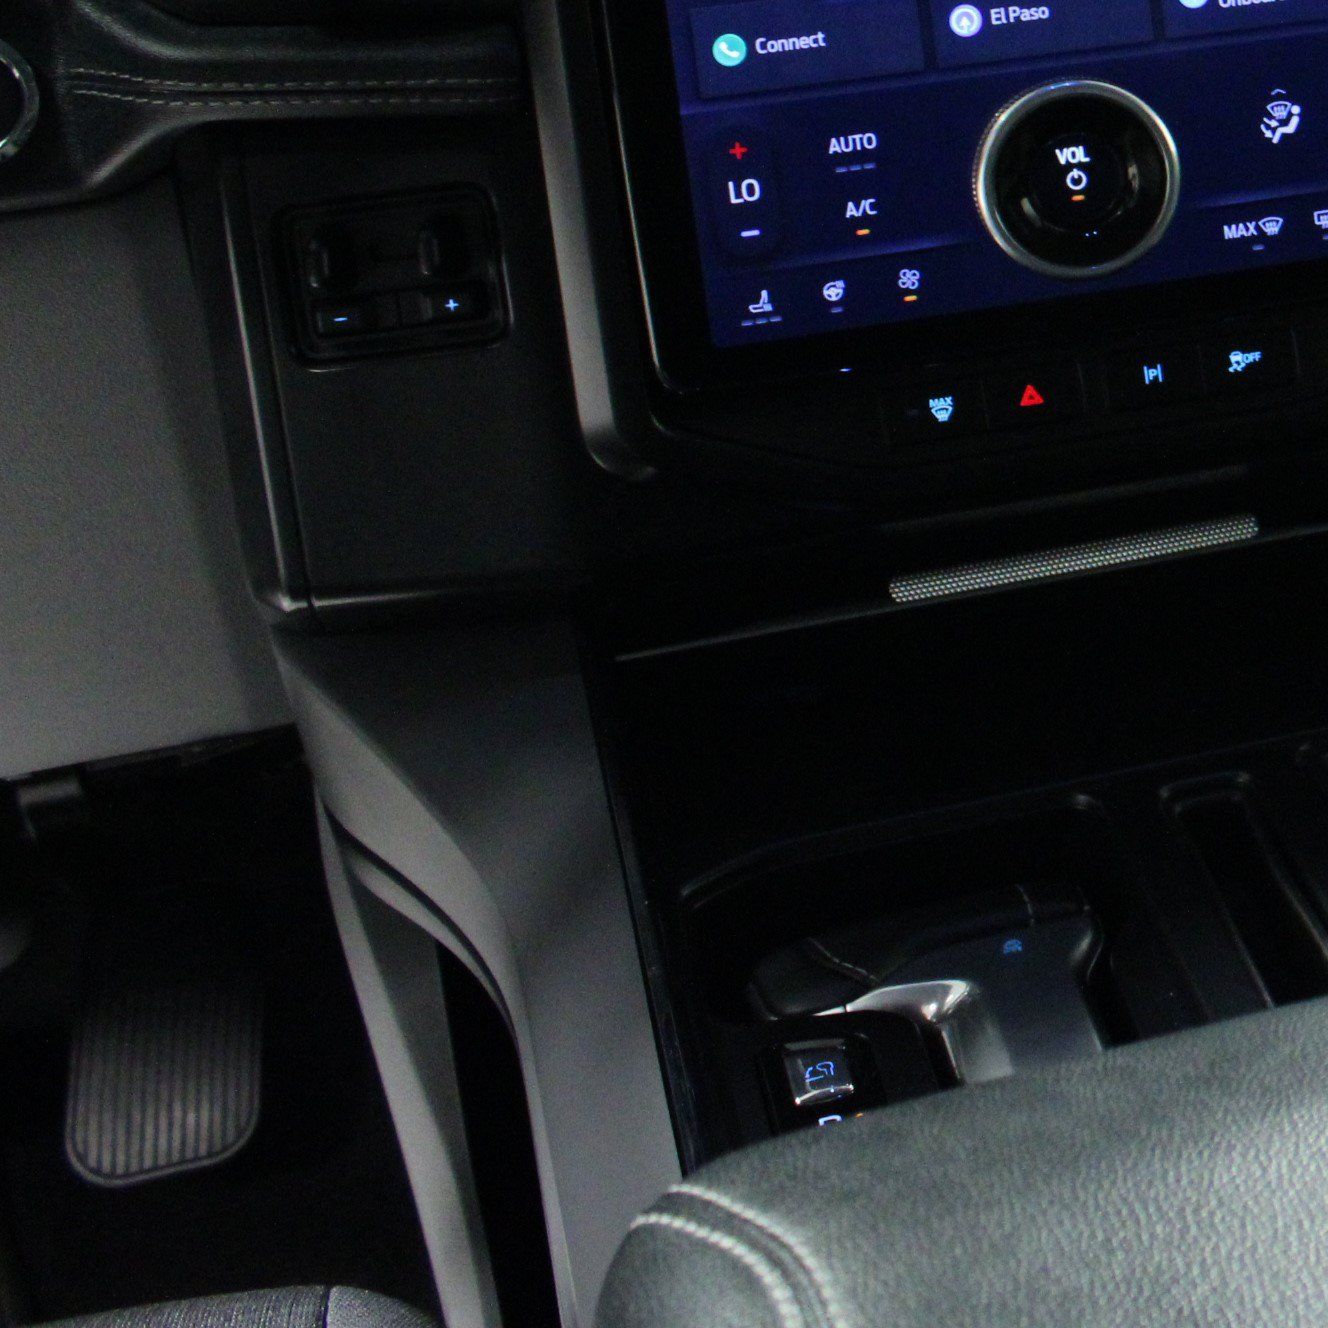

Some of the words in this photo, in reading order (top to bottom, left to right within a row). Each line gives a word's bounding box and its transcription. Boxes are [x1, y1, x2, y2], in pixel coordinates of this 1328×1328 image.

[990, 7, 1008, 25] El
[1010, 3, 1049, 24] Paso
[755, 31, 825, 54] Connect
[828, 132, 878, 155] AUTO
[1056, 145, 1090, 165] VOL
[727, 178, 761, 205] LO
[845, 197, 877, 219] A/C
[1223, 221, 1257, 240] MAX
[929, 396, 953, 408] MAX
